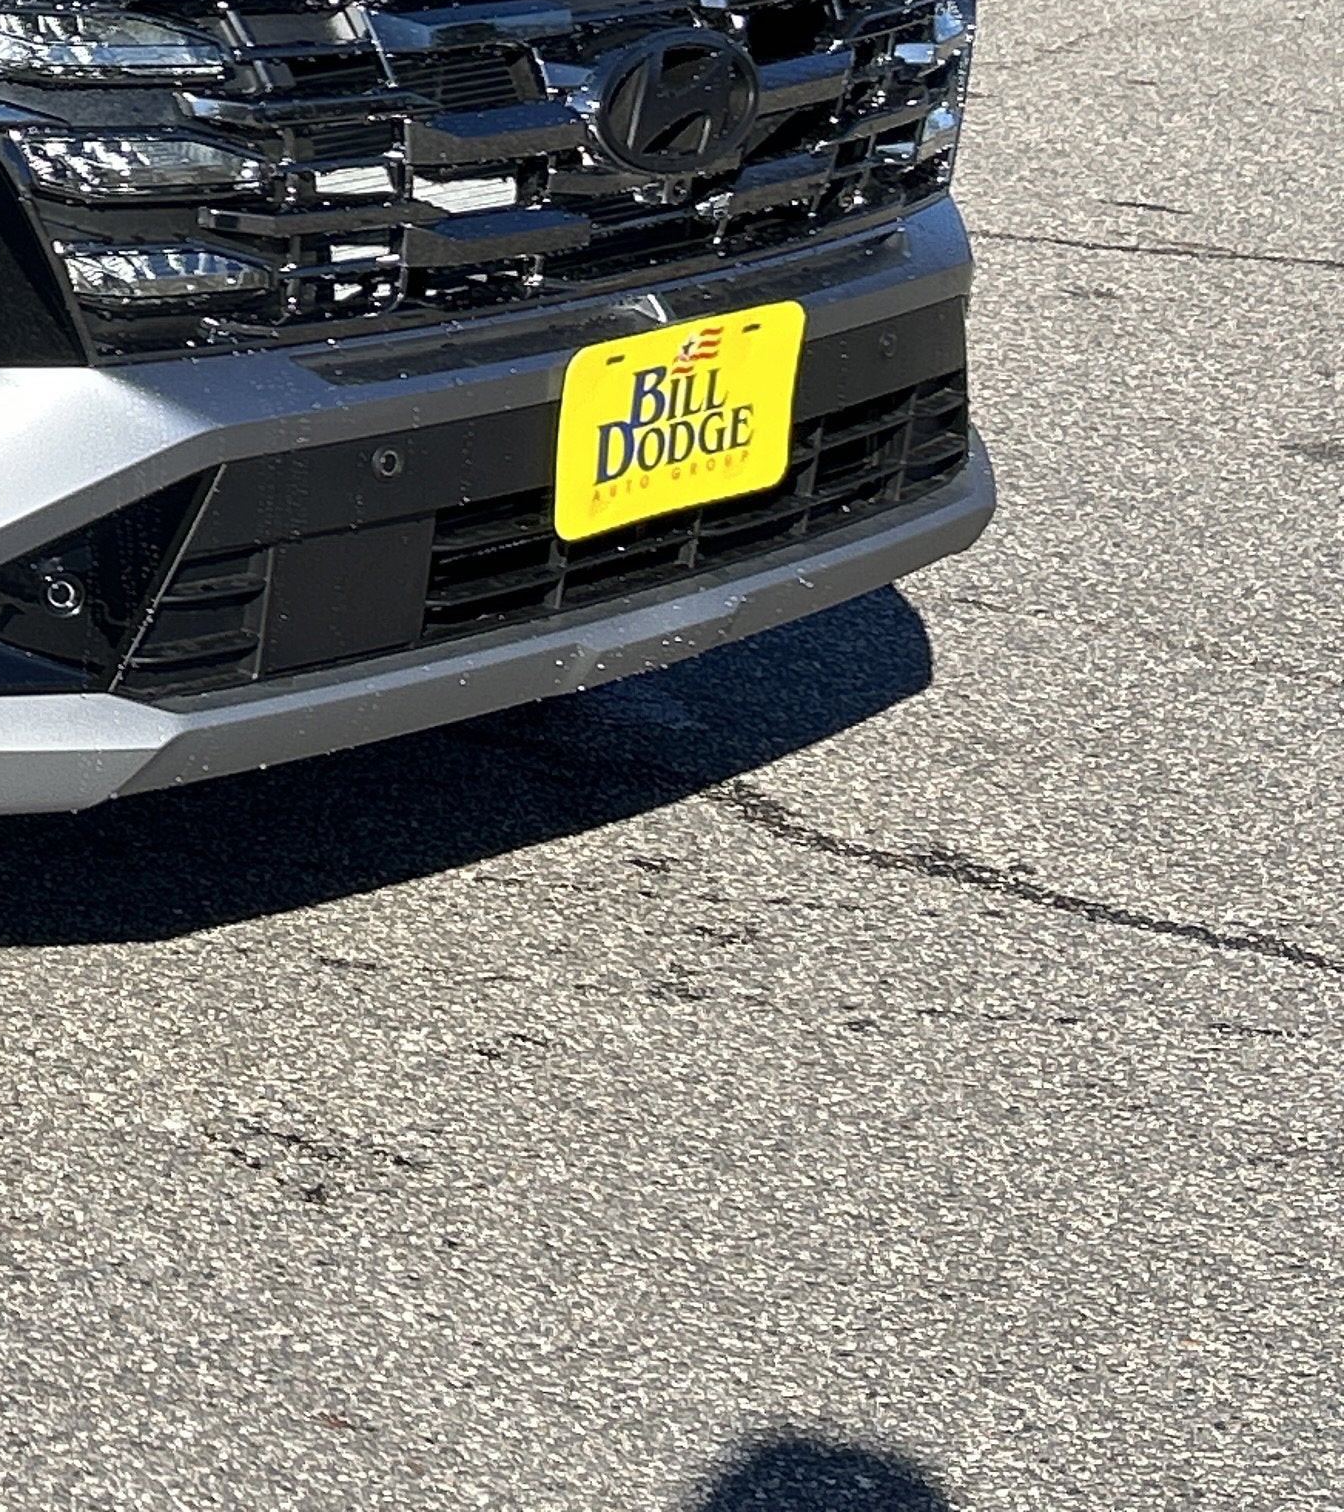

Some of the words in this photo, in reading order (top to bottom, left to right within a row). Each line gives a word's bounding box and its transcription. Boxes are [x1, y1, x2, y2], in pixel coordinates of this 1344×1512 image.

[627, 365, 728, 429] BILL
[593, 403, 754, 485] DODGE
[591, 475, 650, 503] AUTO
[671, 450, 752, 481] GROUP
